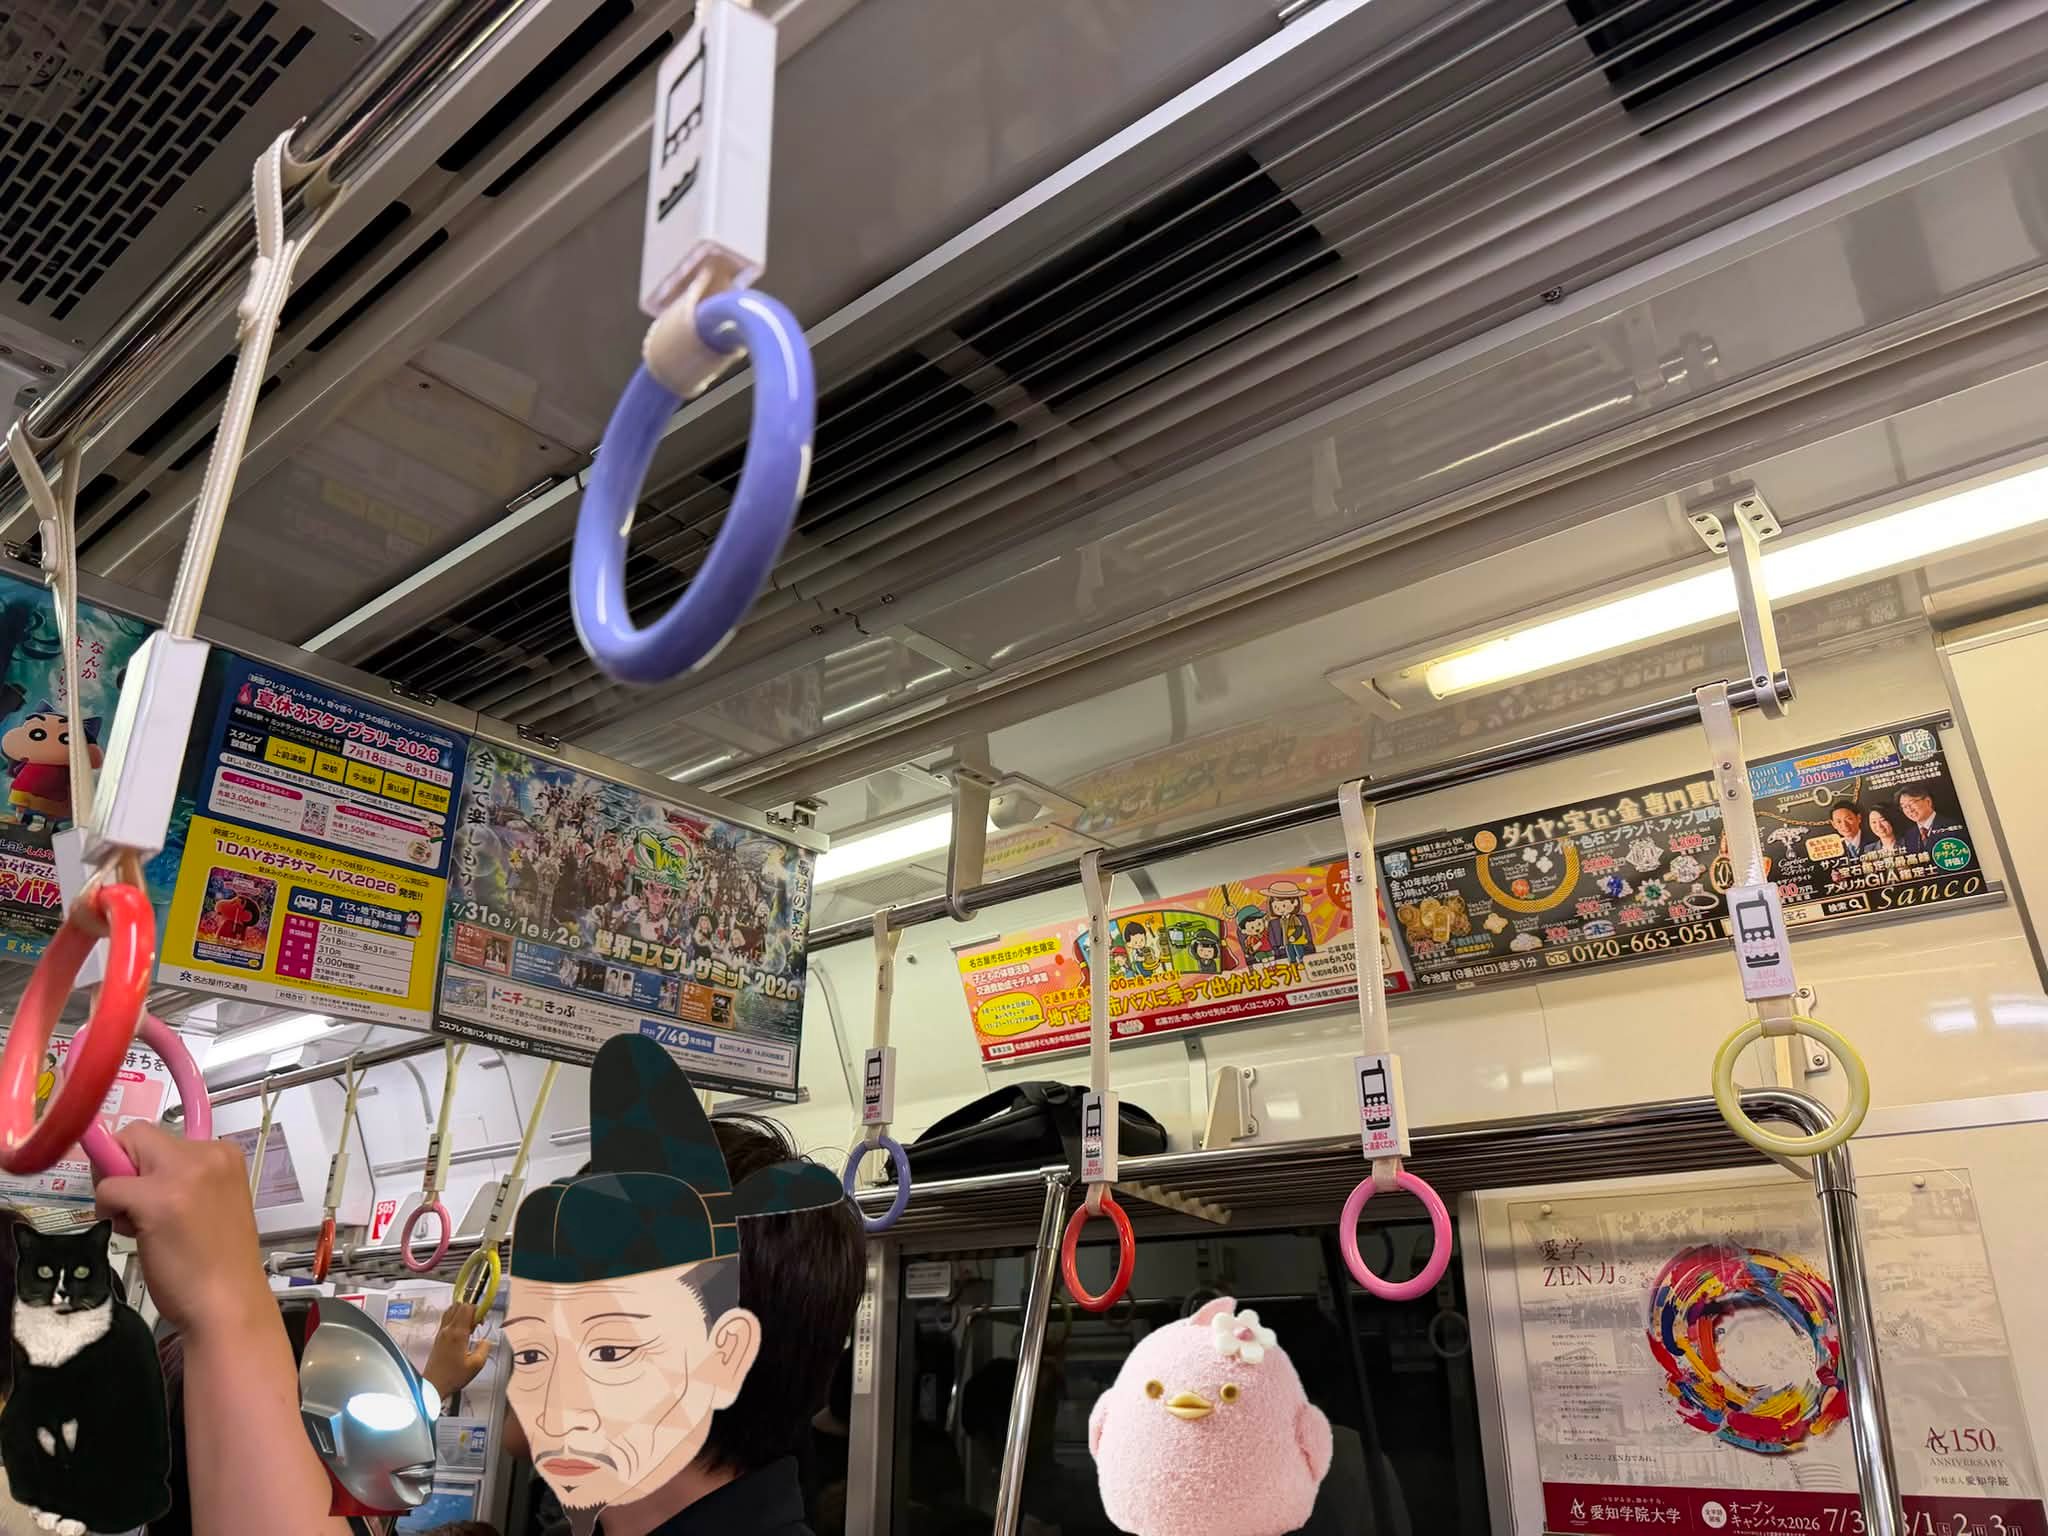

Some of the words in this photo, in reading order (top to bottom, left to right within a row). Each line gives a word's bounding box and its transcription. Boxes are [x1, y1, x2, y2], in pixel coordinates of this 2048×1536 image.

[254, 688, 440, 763] 夏休みスタンプラリー2026
[229, 728, 262, 745] スタンプ
[1899, 729, 1931, 745] 即金
[1906, 738, 1932, 754] OK!
[352, 772, 377, 786] 今池駅
[417, 789, 448, 805] 名古屋駅
[1778, 791, 1812, 803] TIFFANY
[461, 750, 495, 898] 全力で楽しもう。
[1501, 796, 1641, 848] ダイヤ・宝石・金
[215, 839, 397, 895] 1DAYお子サマーパス2026
[398, 888, 424, 902] 発売!!
[1391, 868, 1409, 879] OK!
[1823, 863, 1939, 896] アメリカGIA鑑定士
[1878, 875, 1981, 911] Sanco
[1784, 909, 1808, 922] 宝石
[1828, 902, 1848, 914] 検索
[318, 944, 342, 957] 310円
[1572, 922, 1718, 963] 0120-663-051
[969, 940, 1057, 968] 名古屋市在住の小学生限定
[595, 928, 750, 990] 世界コスプレサミット
[753, 971, 800, 1001] 2026
[1421, 963, 1498, 985] 今池駅(9番出口)
[1498, 957, 1538, 973] 徒歩1分
[193, 975, 248, 993] 名古屋市交通局
[492, 985, 577, 1018] ドニチエコきっぷ
[377, 1201, 395, 1215] SOS
[1538, 1238, 1594, 1262] 愛学、
[1950, 1428, 1997, 1453] 150
[1929, 1458, 2005, 1469] ANNIVERSARY
[1965, 1475, 2010, 1488] 愛知学院
[1590, 1504, 1682, 1526] 愛知学院大学
[1729, 1501, 1775, 1516] オープン
[1731, 1514, 1821, 1532] キャンパス2026
